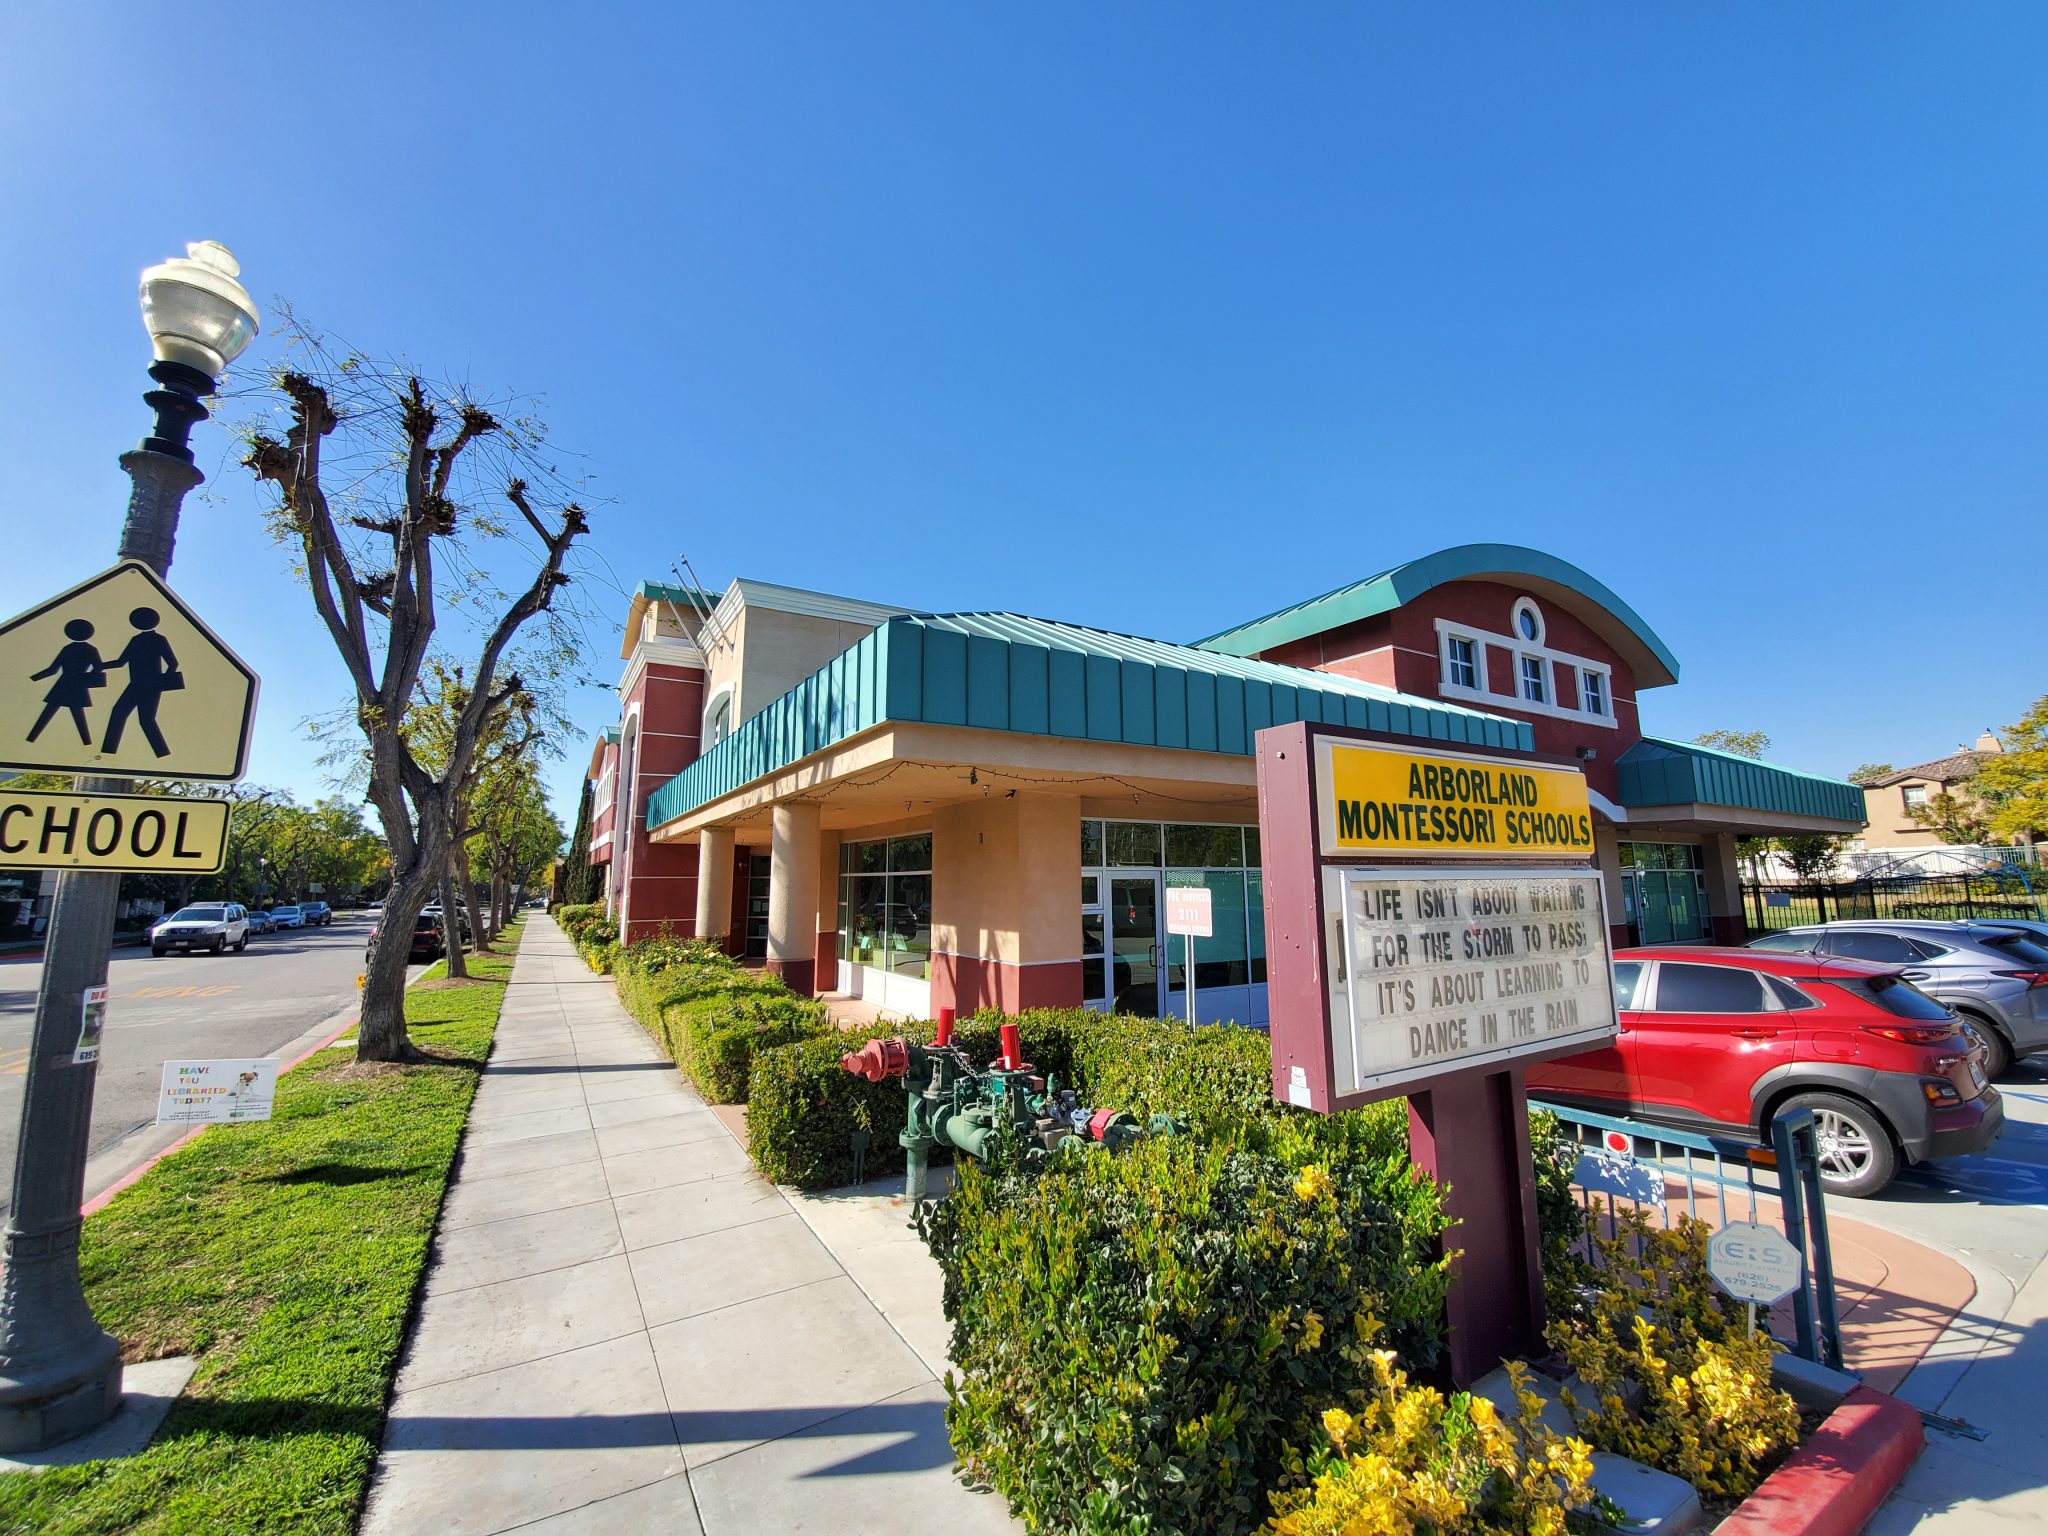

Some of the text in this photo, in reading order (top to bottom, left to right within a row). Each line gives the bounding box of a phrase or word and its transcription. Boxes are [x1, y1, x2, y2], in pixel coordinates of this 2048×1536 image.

[1408, 762, 1538, 807] ARBORLAND
[1338, 799, 1590, 846] MONTESSORI SCHOOLS
[1178, 907, 1199, 921] 2111
[1363, 884, 1585, 921] LIFE ISN'T ABOUT WAITING
[1372, 934, 1409, 968] FOR
[1420, 931, 1453, 963] THE
[1463, 926, 1515, 959] STORM
[1522, 924, 1541, 952] TO
[1378, 958, 1590, 1016] IT'S ABOUT LEARNING TO
[1409, 999, 1579, 1059] DANCE IN THE RAIN
[179, 1067, 211, 1075] HAVE
[180, 1077, 199, 1085] YOU
[167, 1087, 227, 1096] LIBRARIED
[172, 1097, 212, 1105] TODAY?
